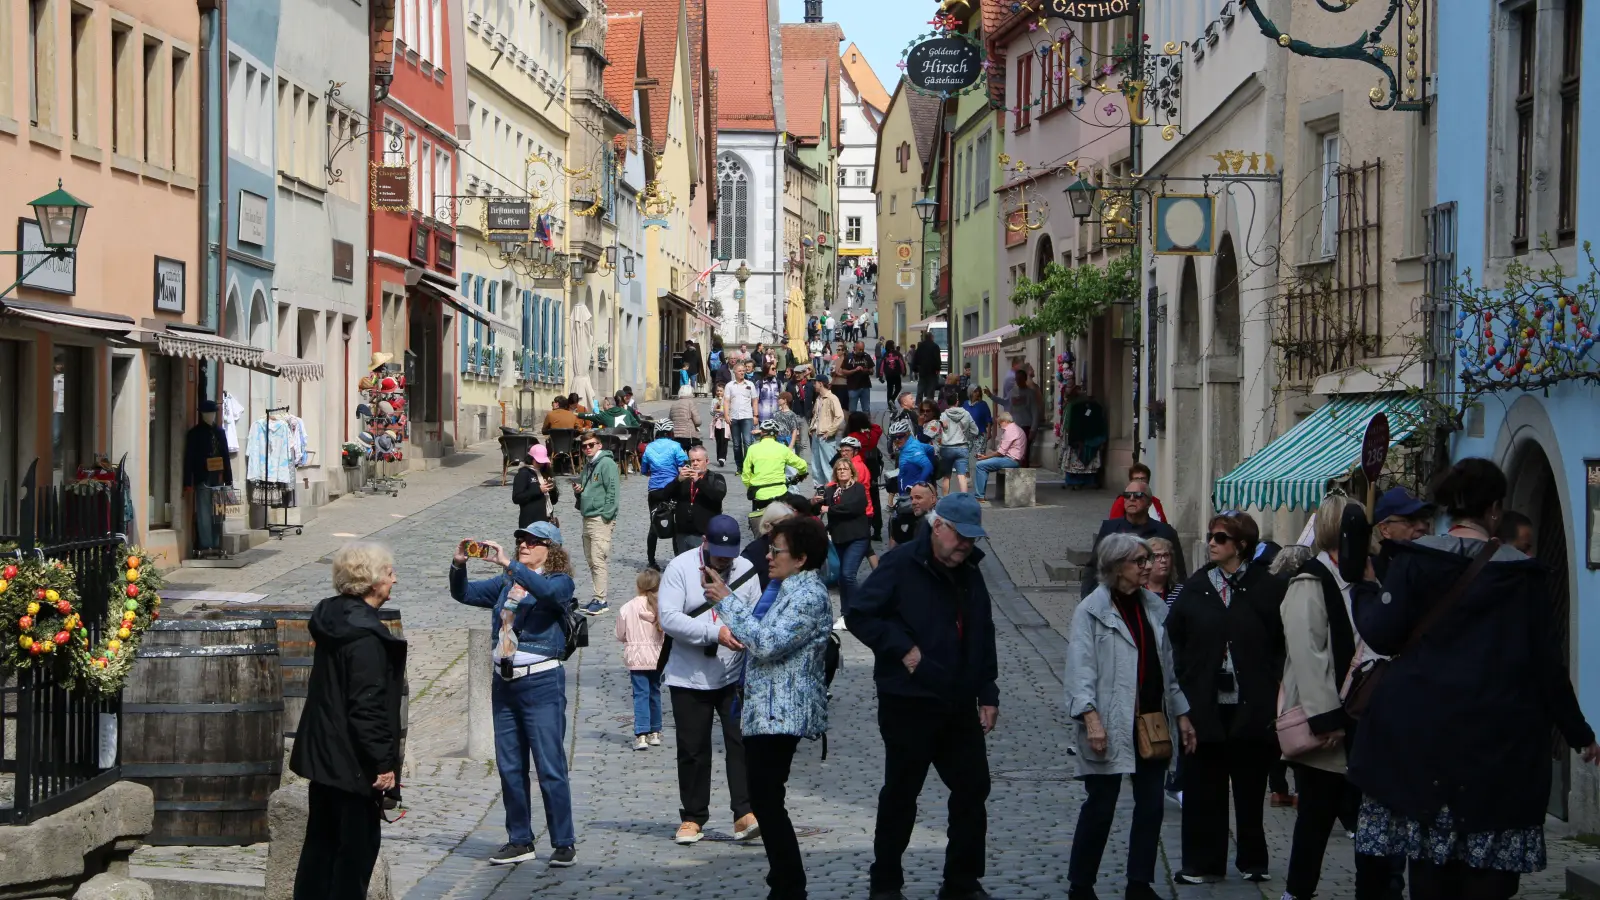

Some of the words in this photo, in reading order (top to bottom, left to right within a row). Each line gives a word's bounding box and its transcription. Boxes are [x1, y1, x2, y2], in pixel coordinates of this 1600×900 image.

[1053, 0, 1130, 17] GASTHOF
[928, 46, 960, 57] Goldener
[921, 58, 968, 73] Hirsch
[924, 75, 964, 86] Gästehaus
